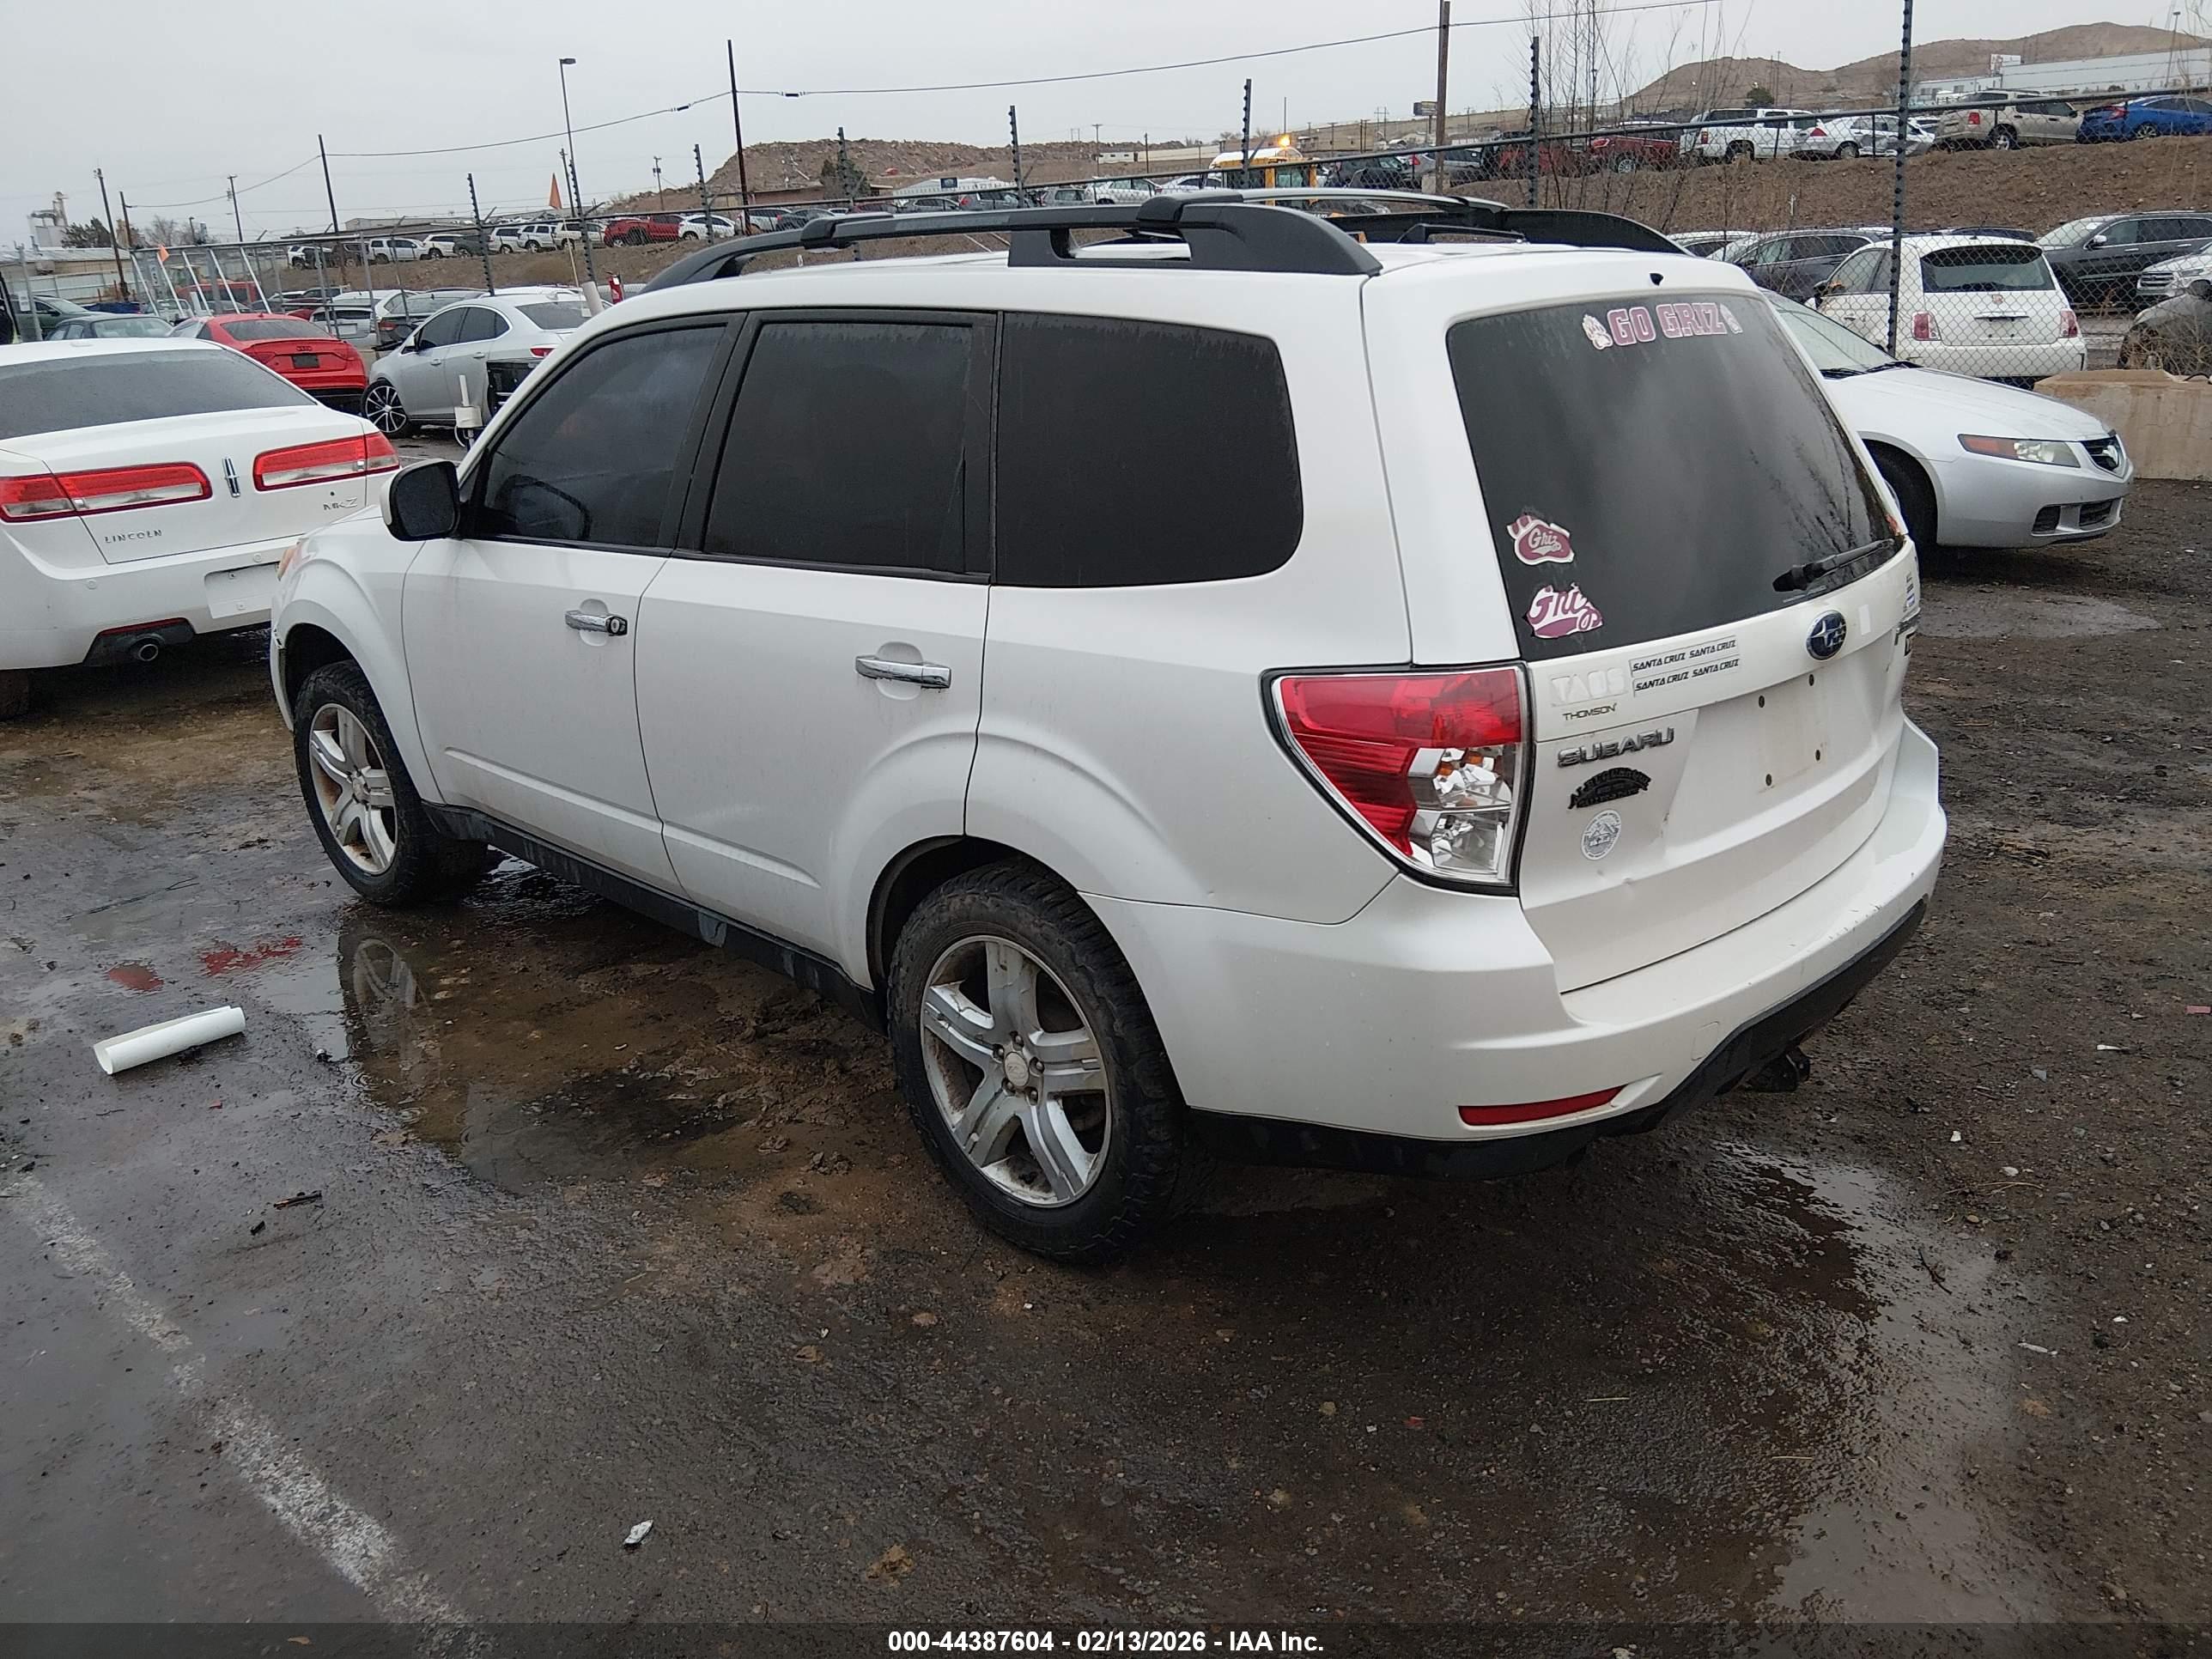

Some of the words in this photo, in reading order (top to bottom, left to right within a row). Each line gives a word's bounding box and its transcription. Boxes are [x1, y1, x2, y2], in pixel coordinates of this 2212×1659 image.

[1607, 307, 1657, 346] GO
[1656, 303, 1728, 338] GRIZ
[323, 497, 358, 510] MKZ
[104, 529, 162, 544] LINCOLN
[1528, 527, 1561, 551] Griz
[1632, 658, 1662, 672] SANTA
[1663, 652, 1686, 665] CRUZ
[1689, 645, 1716, 659] SANTA
[1717, 639, 1736, 651] CRUZ
[1635, 678, 1666, 691] SANTA
[1667, 672, 1689, 684] CRUZ
[1692, 665, 1718, 678] SANTA
[1719, 659, 1740, 672] CRUZ
[1562, 703, 1617, 721] THOMSON
[1557, 726, 1674, 768] SUBARU
